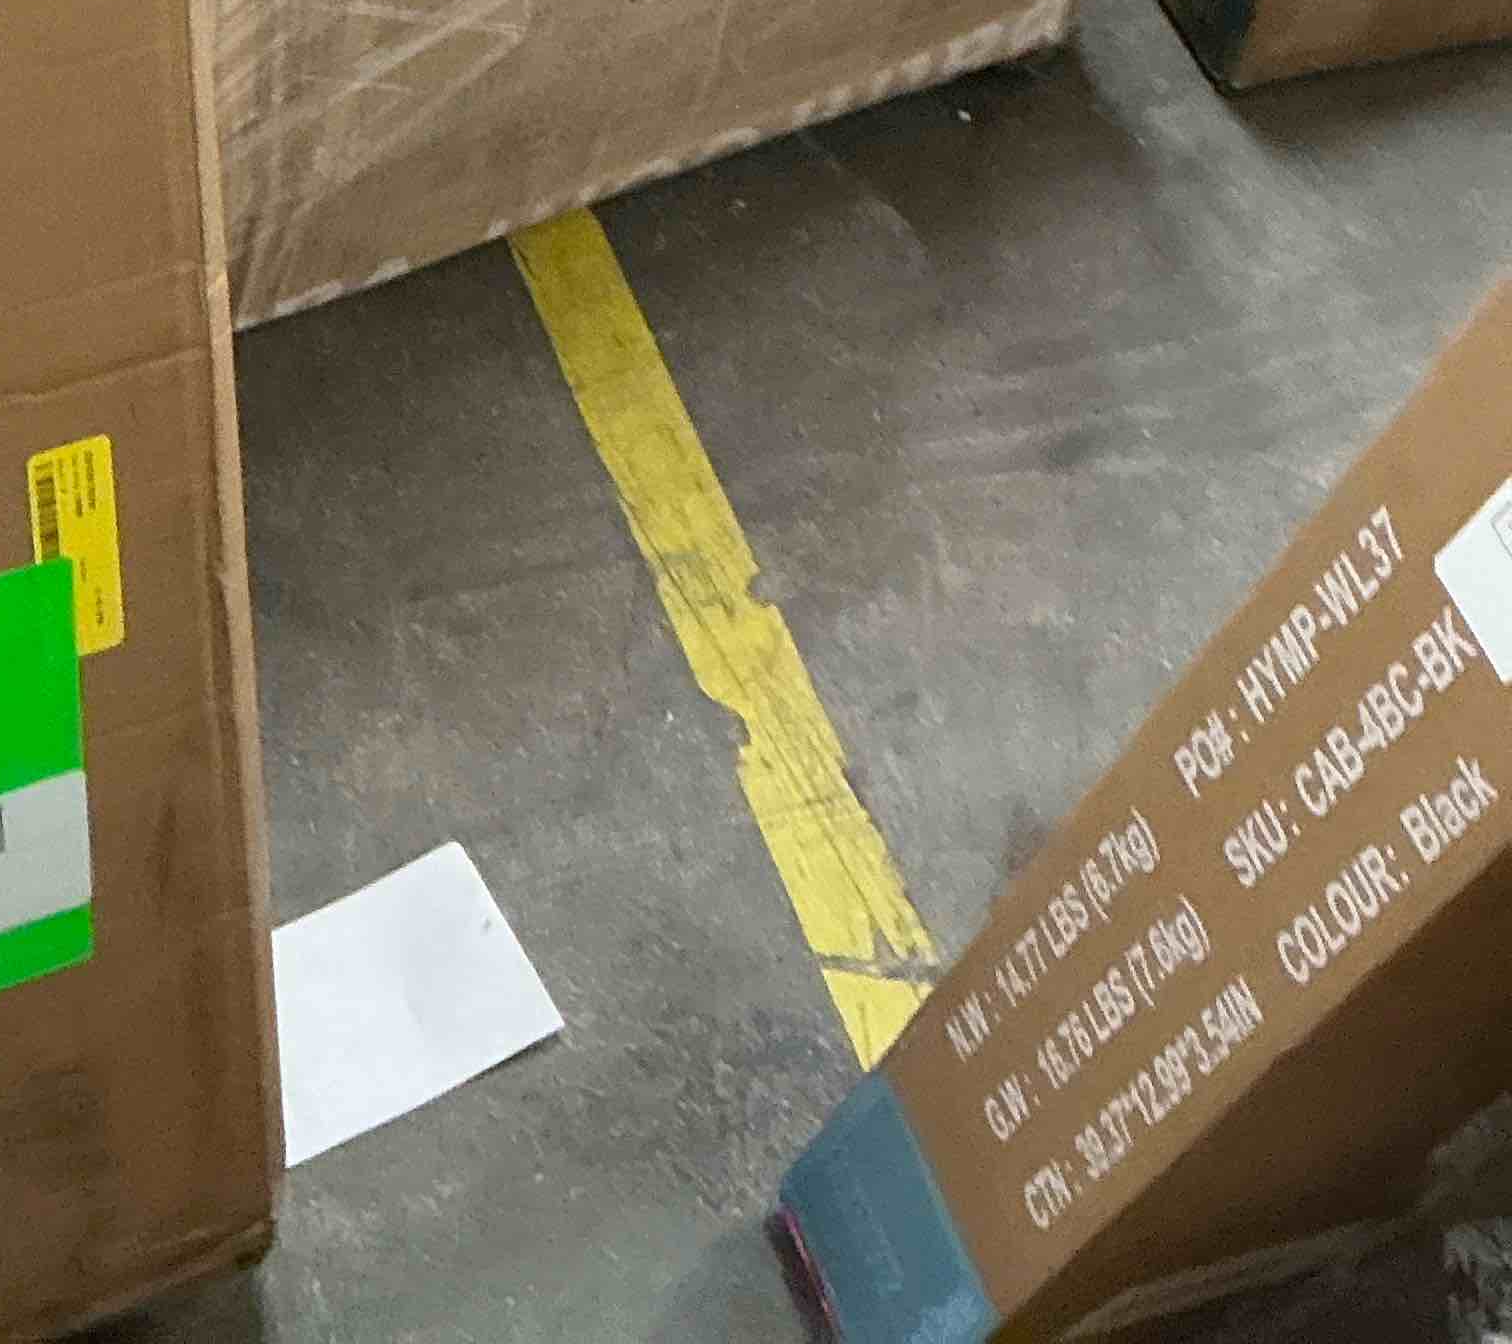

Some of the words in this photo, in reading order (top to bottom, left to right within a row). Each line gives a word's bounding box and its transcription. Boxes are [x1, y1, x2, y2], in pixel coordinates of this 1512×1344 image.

[1236, 504, 1405, 723] HYMP-WL37
[1223, 799, 1302, 888] SKU:
[1294, 605, 1481, 817] CAB-4BC-BK
[995, 927, 1049, 1008] 14.77
[1038, 882, 1090, 960] LBS
[1080, 805, 1161, 923] (6.7kg)
[1082, 965, 1136, 1044] LBS
[1124, 892, 1212, 1009] (7.6kg)
[1276, 843, 1411, 984] COLOUR:
[1399, 755, 1499, 865] Black
